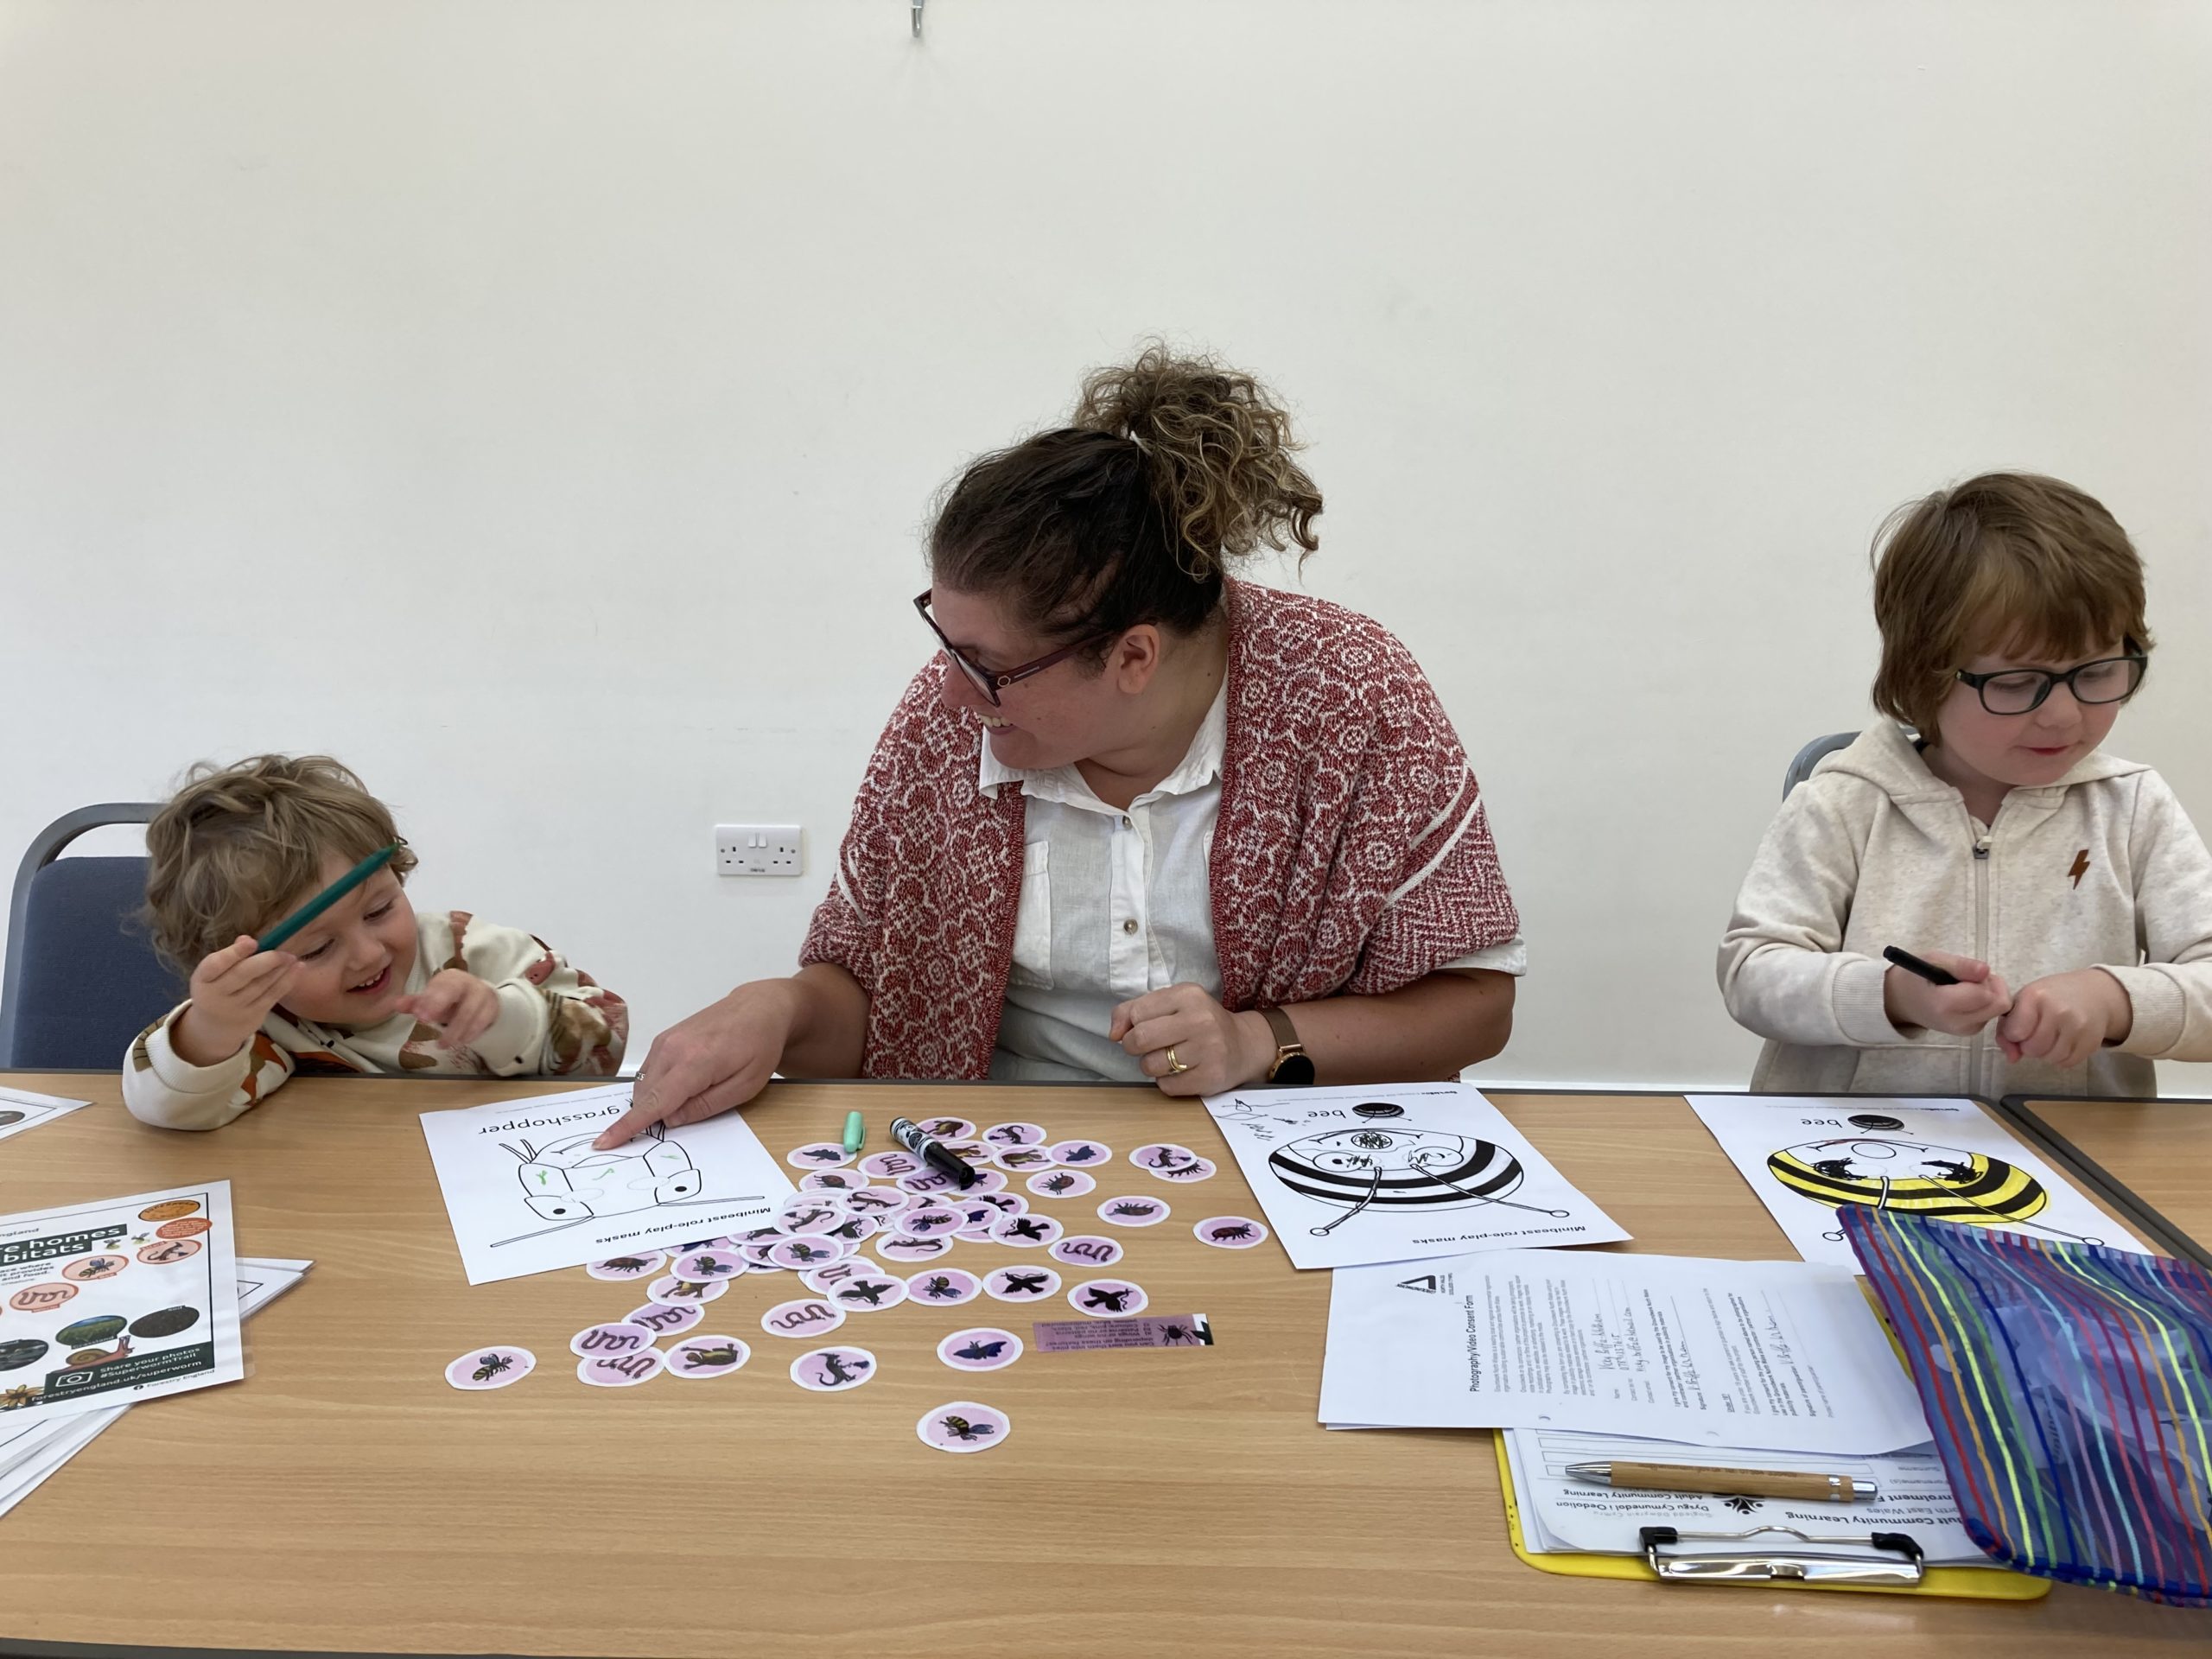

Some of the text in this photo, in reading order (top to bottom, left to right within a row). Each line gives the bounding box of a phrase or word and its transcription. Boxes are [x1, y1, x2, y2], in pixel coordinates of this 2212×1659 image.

[1307, 1109, 1346, 1118] bee
[478, 1105, 621, 1134] grasshopper
[1801, 1118, 1842, 1128] bee
[595, 1207, 770, 1243] Minibeast role-play masks
[1521, 1226, 1586, 1235] Minibeast
[0, 1228, 39, 1236] ngland
[1460, 1231, 1517, 1240] role-play
[29, 1228, 119, 1249] homes
[3, 1243, 84, 1262] bitats
[10, 1266, 54, 1275] provides
[73, 1335, 113, 1349] Grassland
[1463, 1294, 1482, 1391] Photography/Video Consent Form
[100, 1347, 200, 1372] Share your photos
[100, 1352, 195, 1377] #SuperwormTrail
[31, 1361, 201, 1401] forestryengland.uk/superworm
[145, 1369, 214, 1387] Forestry England
[1563, 1489, 1609, 1498] Learning
[1611, 1491, 1671, 1499] Community
[1677, 1503, 1709, 1512] Dysgu
[1866, 1506, 1958, 1516] orth East Wales
[1785, 1511, 1849, 1523] Learning
[1853, 1516, 1935, 1524] Community
